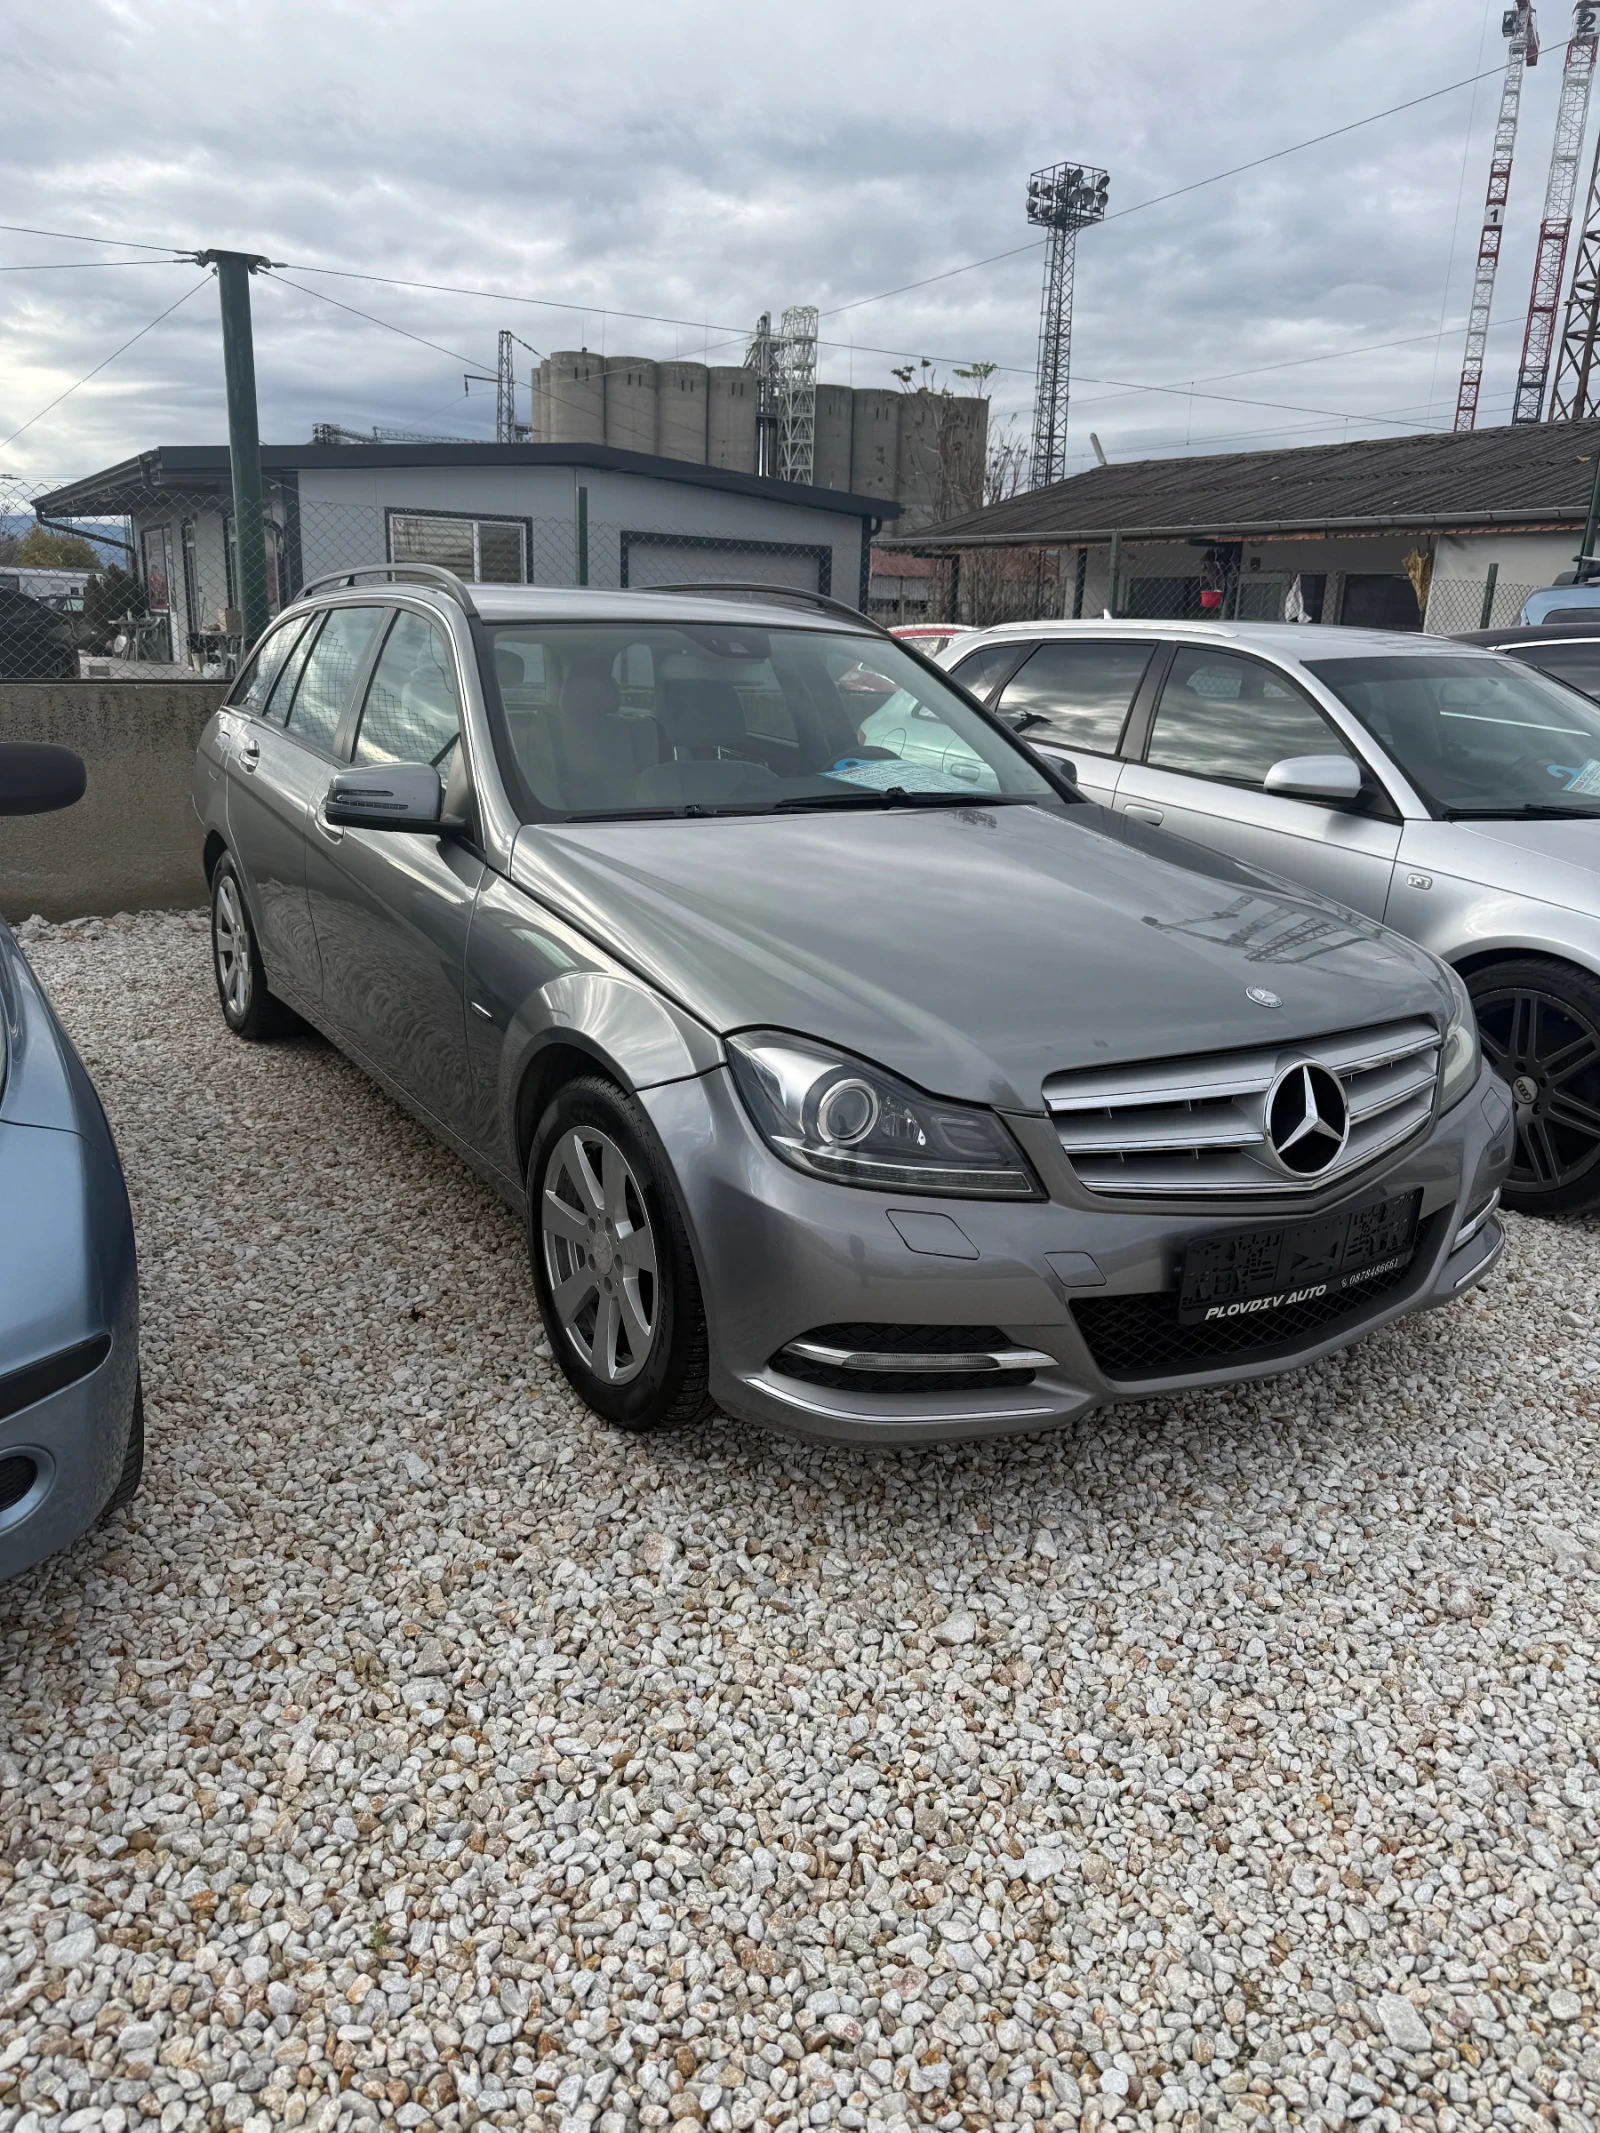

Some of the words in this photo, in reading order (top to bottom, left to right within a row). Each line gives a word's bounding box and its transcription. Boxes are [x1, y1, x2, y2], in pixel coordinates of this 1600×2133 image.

[1580, 12, 1596, 32] 2
[1490, 209, 1498, 222] 1
[1204, 1294, 1285, 1320] PLOVDIV
[1285, 1284, 1327, 1304] AUTO
